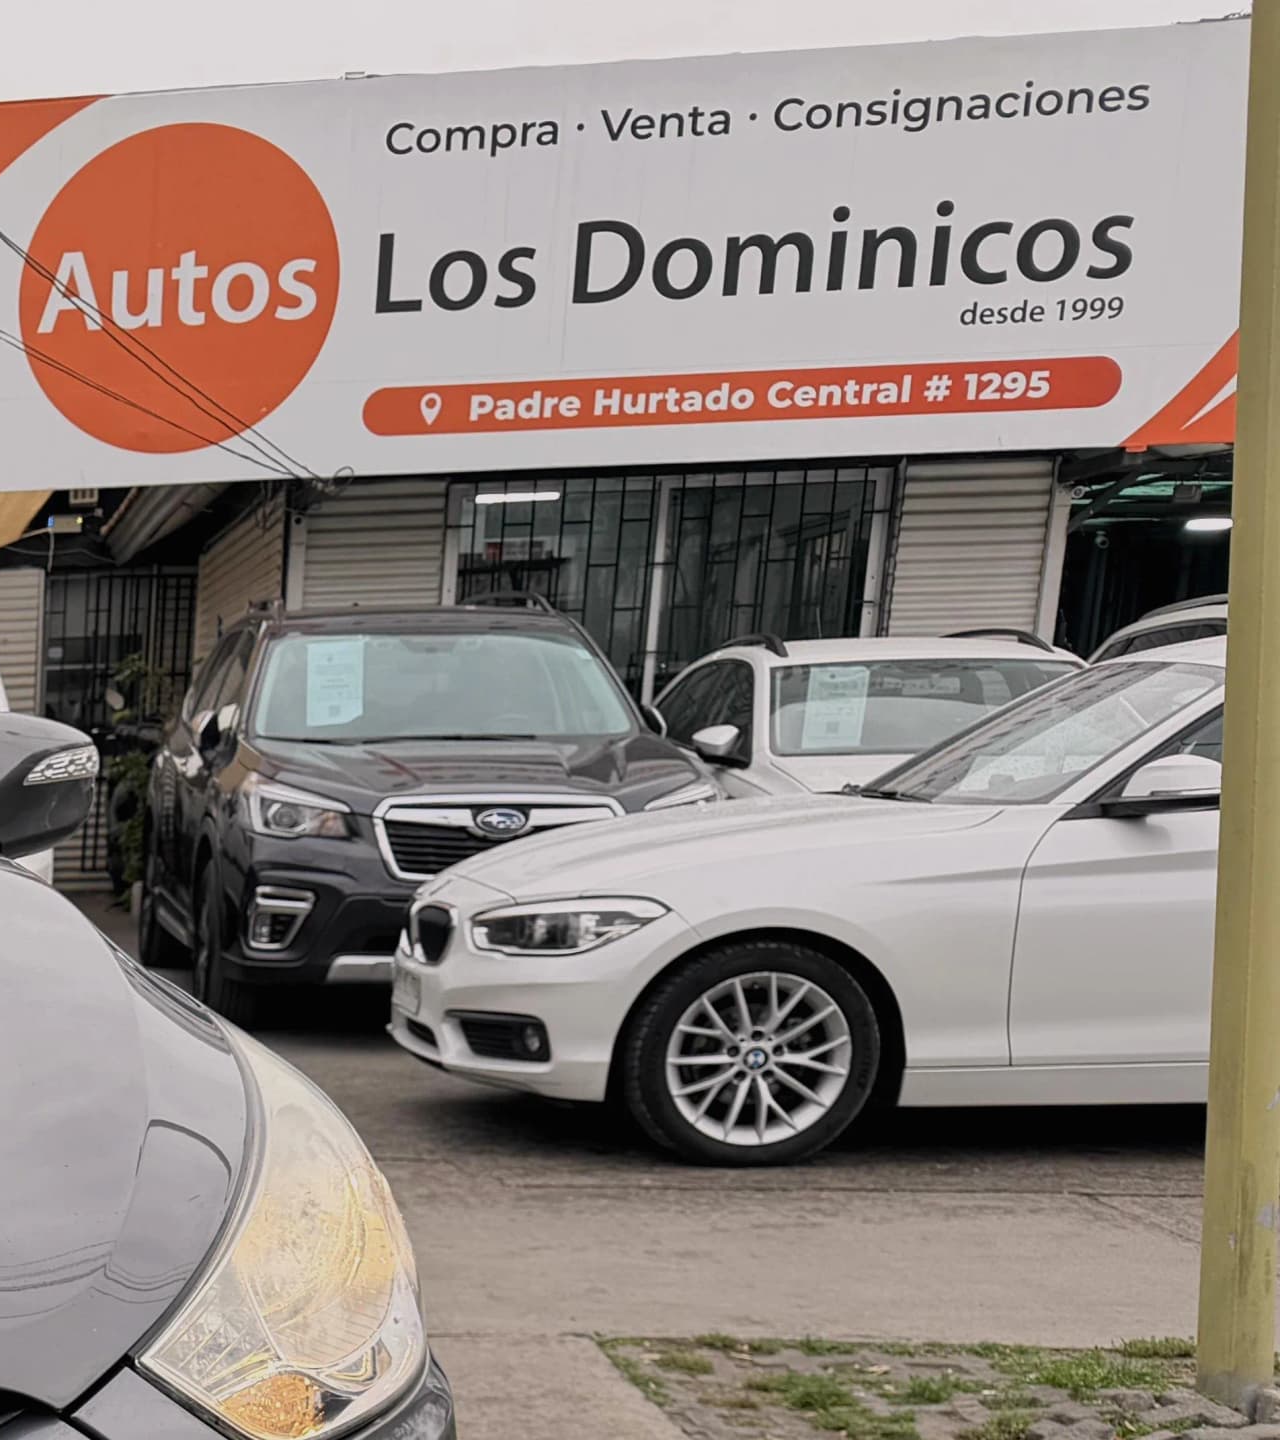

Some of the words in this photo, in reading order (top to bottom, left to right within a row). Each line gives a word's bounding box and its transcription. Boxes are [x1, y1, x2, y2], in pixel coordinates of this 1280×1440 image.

[385, 120, 559, 158] Compra
[600, 106, 731, 142] Venta
[773, 80, 1150, 133] Consignaciones
[37, 249, 318, 334] Autos
[373, 231, 537, 314] Los
[571, 199, 1136, 305] Dominicos
[959, 300, 1045, 326] desde
[1056, 296, 1125, 321] 1999
[469, 390, 582, 422] Padre
[593, 382, 755, 416] Hurtado
[766, 374, 913, 409] Central
[963, 369, 1051, 401] 1295
